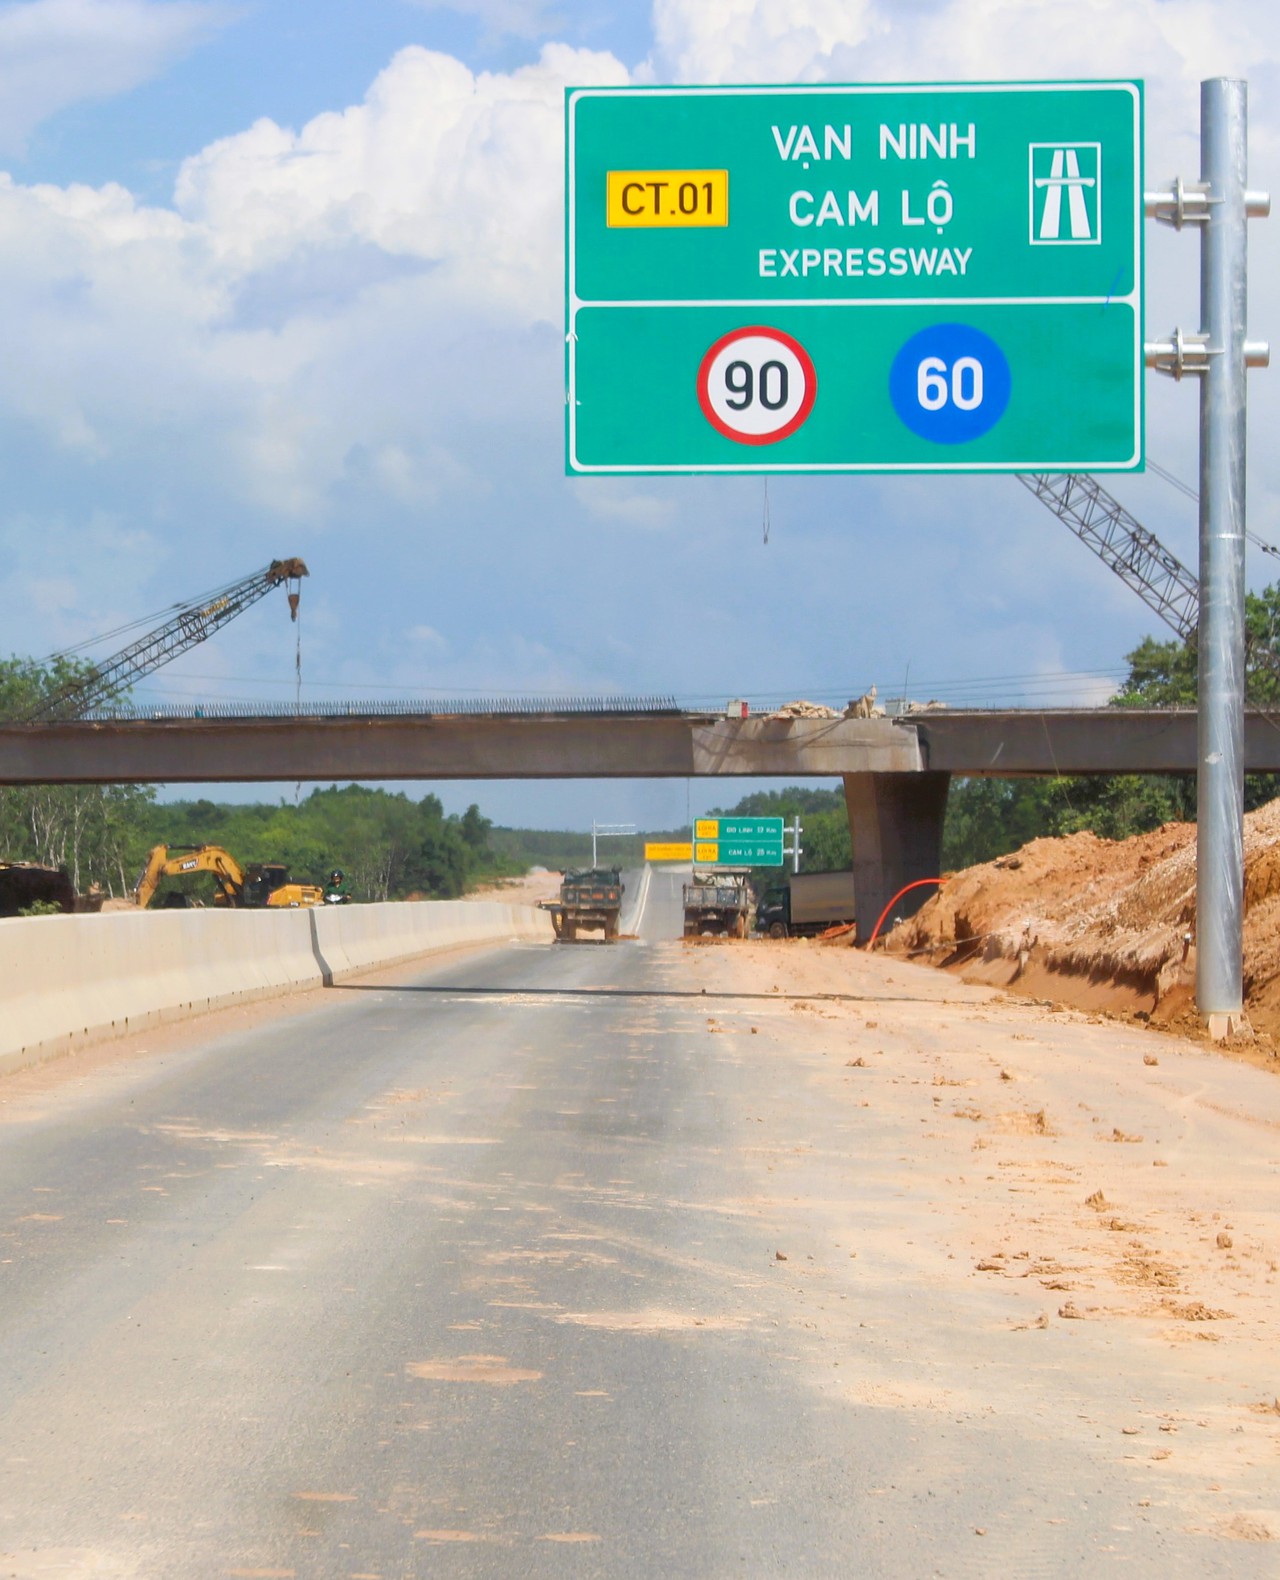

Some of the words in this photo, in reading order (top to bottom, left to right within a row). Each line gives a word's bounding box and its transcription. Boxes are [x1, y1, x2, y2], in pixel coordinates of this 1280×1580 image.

[771, 124, 852, 169] VẠN
[879, 123, 976, 160] NINH
[621, 182, 713, 215] CT.01
[789, 190, 879, 227] CAM
[901, 180, 953, 235] LỘ
[758, 247, 973, 277] EXPRESSWAY
[724, 360, 789, 411] 90
[917, 356, 984, 411] 60
